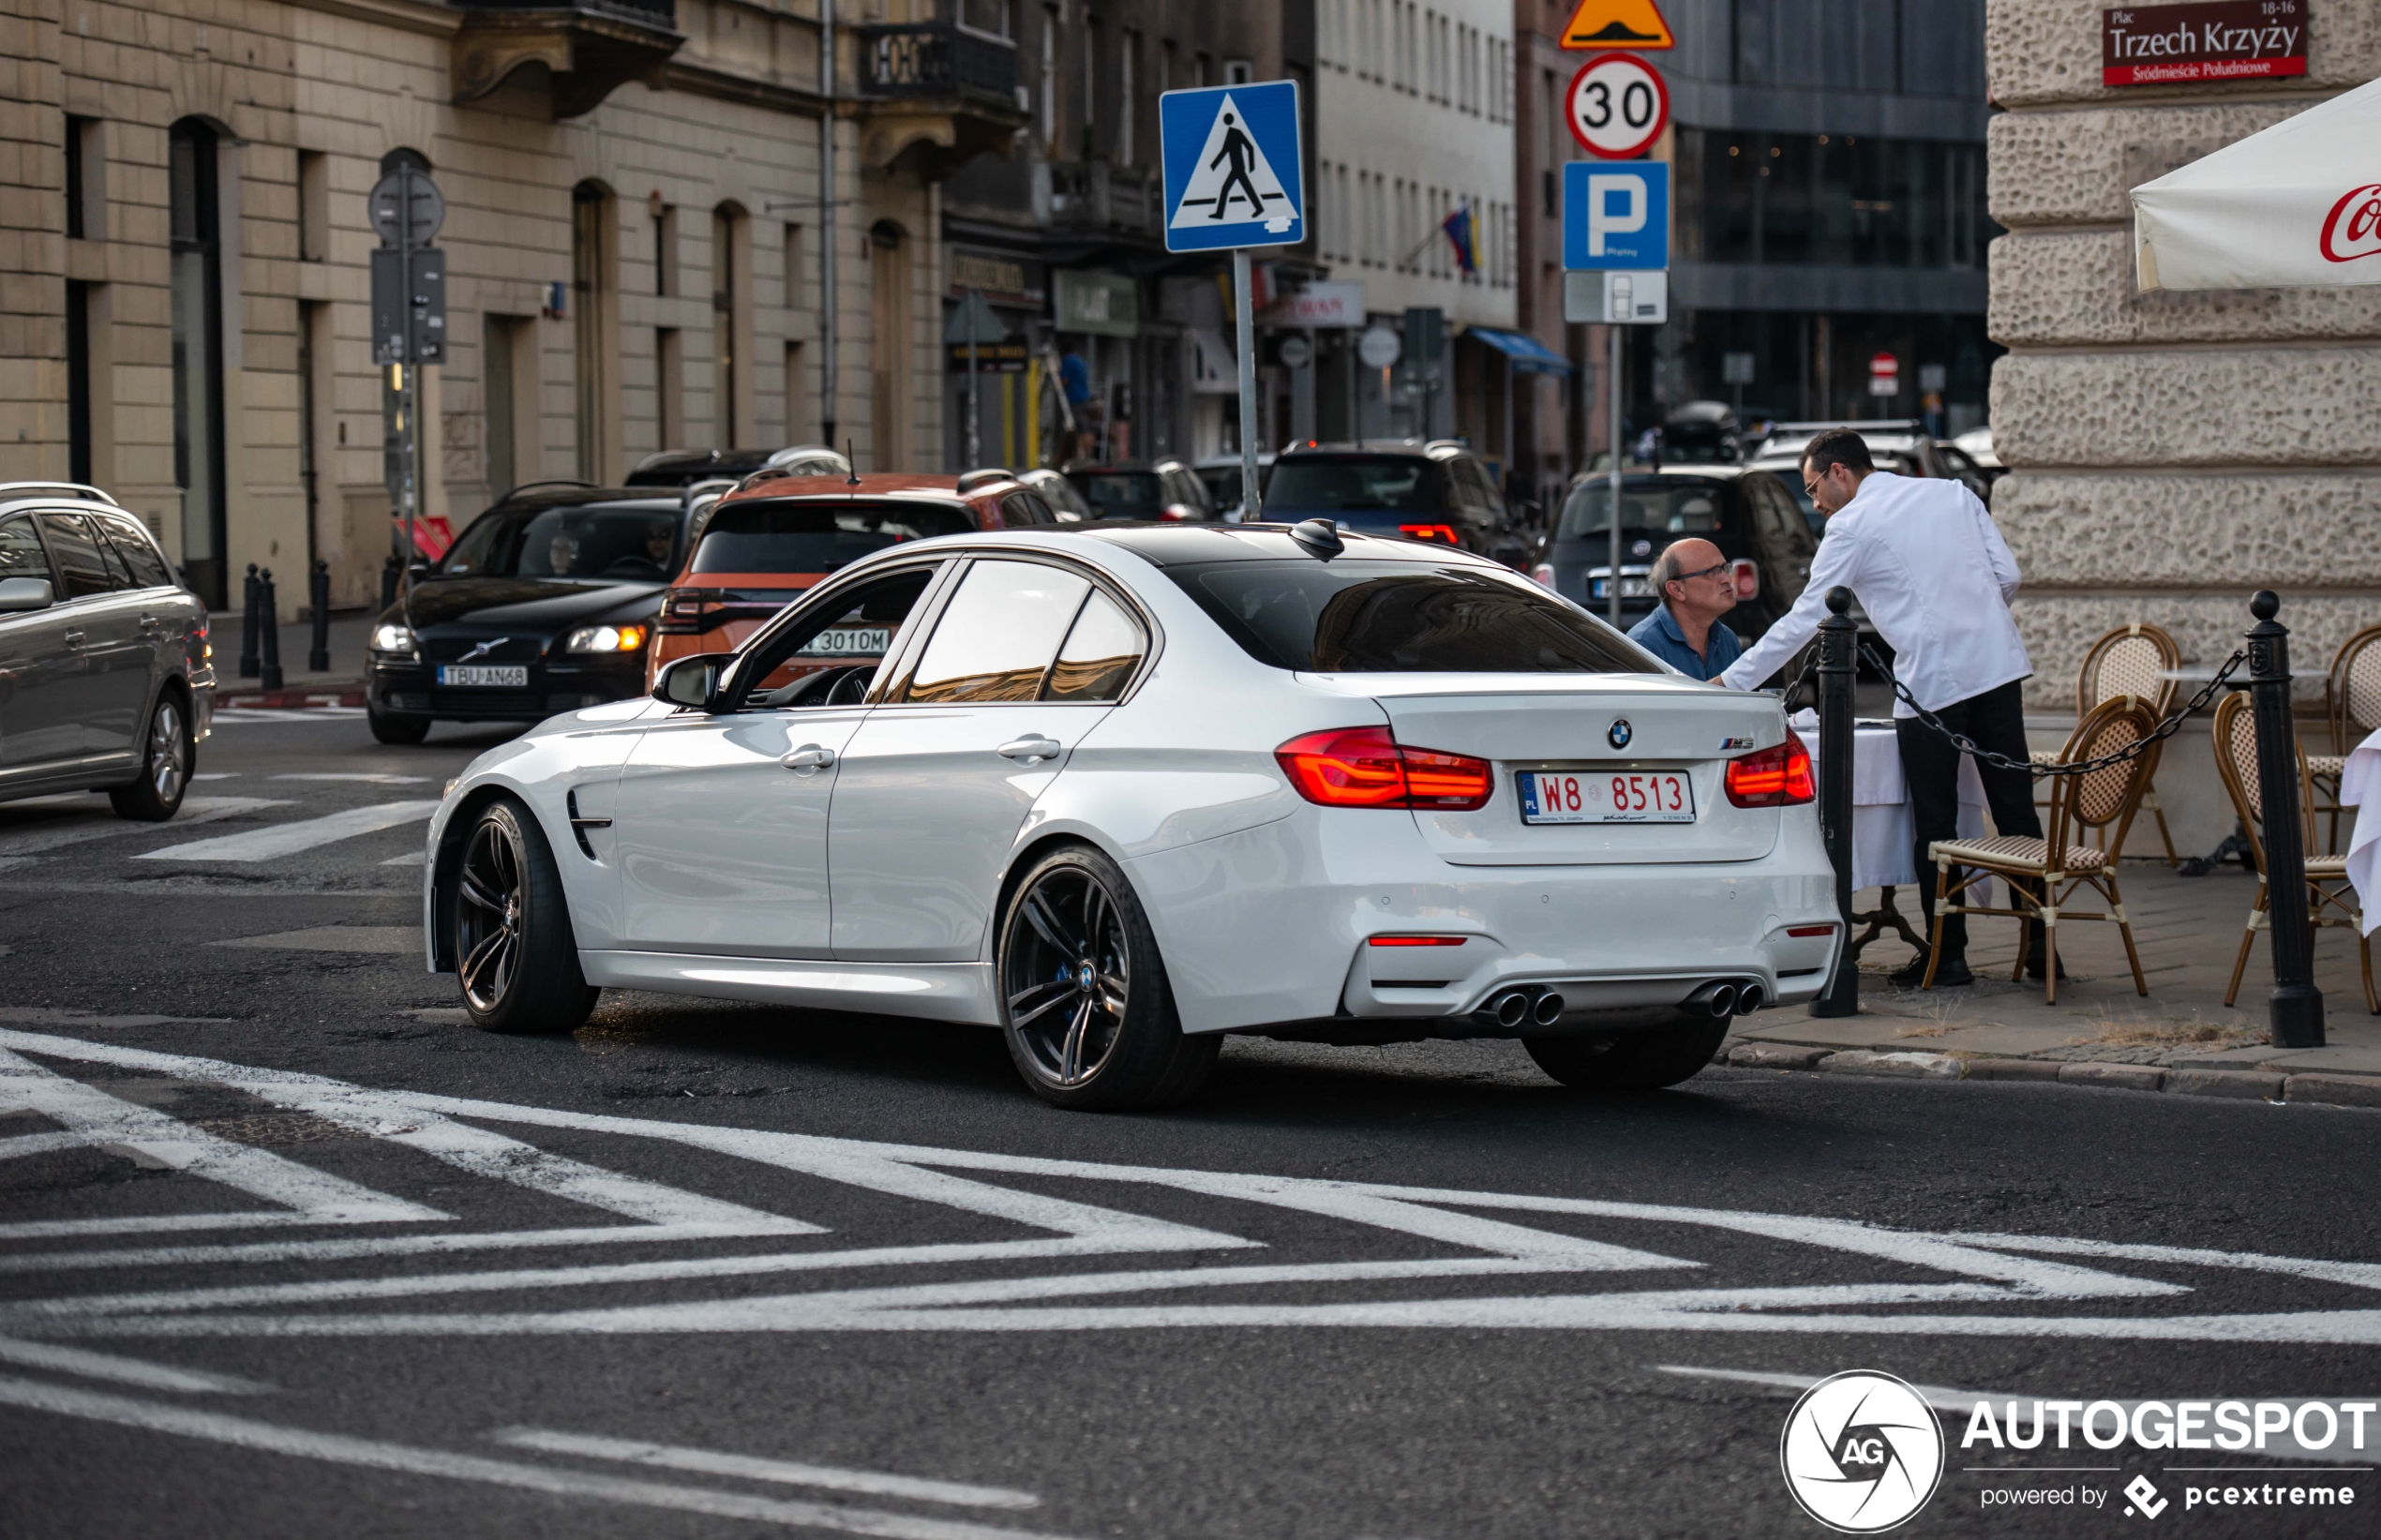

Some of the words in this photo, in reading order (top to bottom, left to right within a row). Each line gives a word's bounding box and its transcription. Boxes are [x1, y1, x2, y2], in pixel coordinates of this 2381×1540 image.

[2112, 10, 2134, 24] Plac
[2261, 1, 2296, 15] 18-16
[2110, 22, 2196, 58] Trzech
[2204, 18, 2299, 59] Krzyży
[2133, 63, 2199, 82] Śródmieście
[1582, 81, 1654, 129] 30
[1588, 173, 1648, 258] P
[821, 632, 884, 650] 3010M
[447, 668, 480, 685] TBU
[485, 668, 524, 685] AN68
[1541, 777, 1582, 812] W8
[1611, 776, 1683, 811] 8513
[1525, 800, 1537, 810] PL
